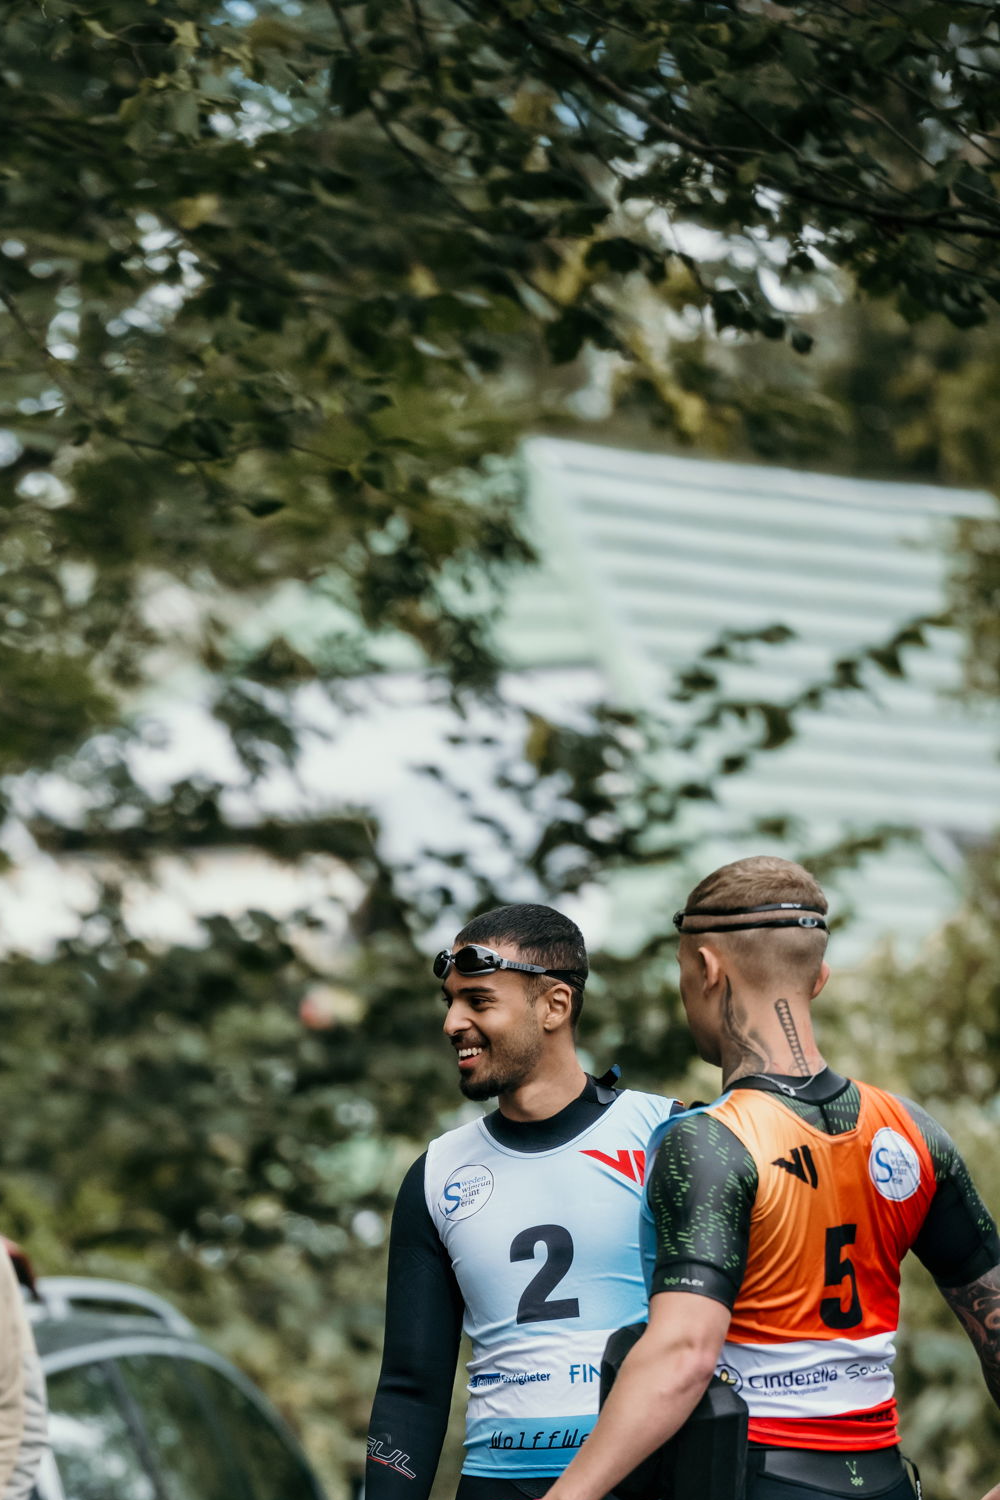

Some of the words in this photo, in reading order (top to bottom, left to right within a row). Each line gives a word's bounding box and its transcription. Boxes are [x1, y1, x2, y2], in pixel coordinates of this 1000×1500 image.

[509, 1224, 580, 1325] 2
[820, 1224, 862, 1329] 5
[749, 1366, 838, 1389] Cinderella
